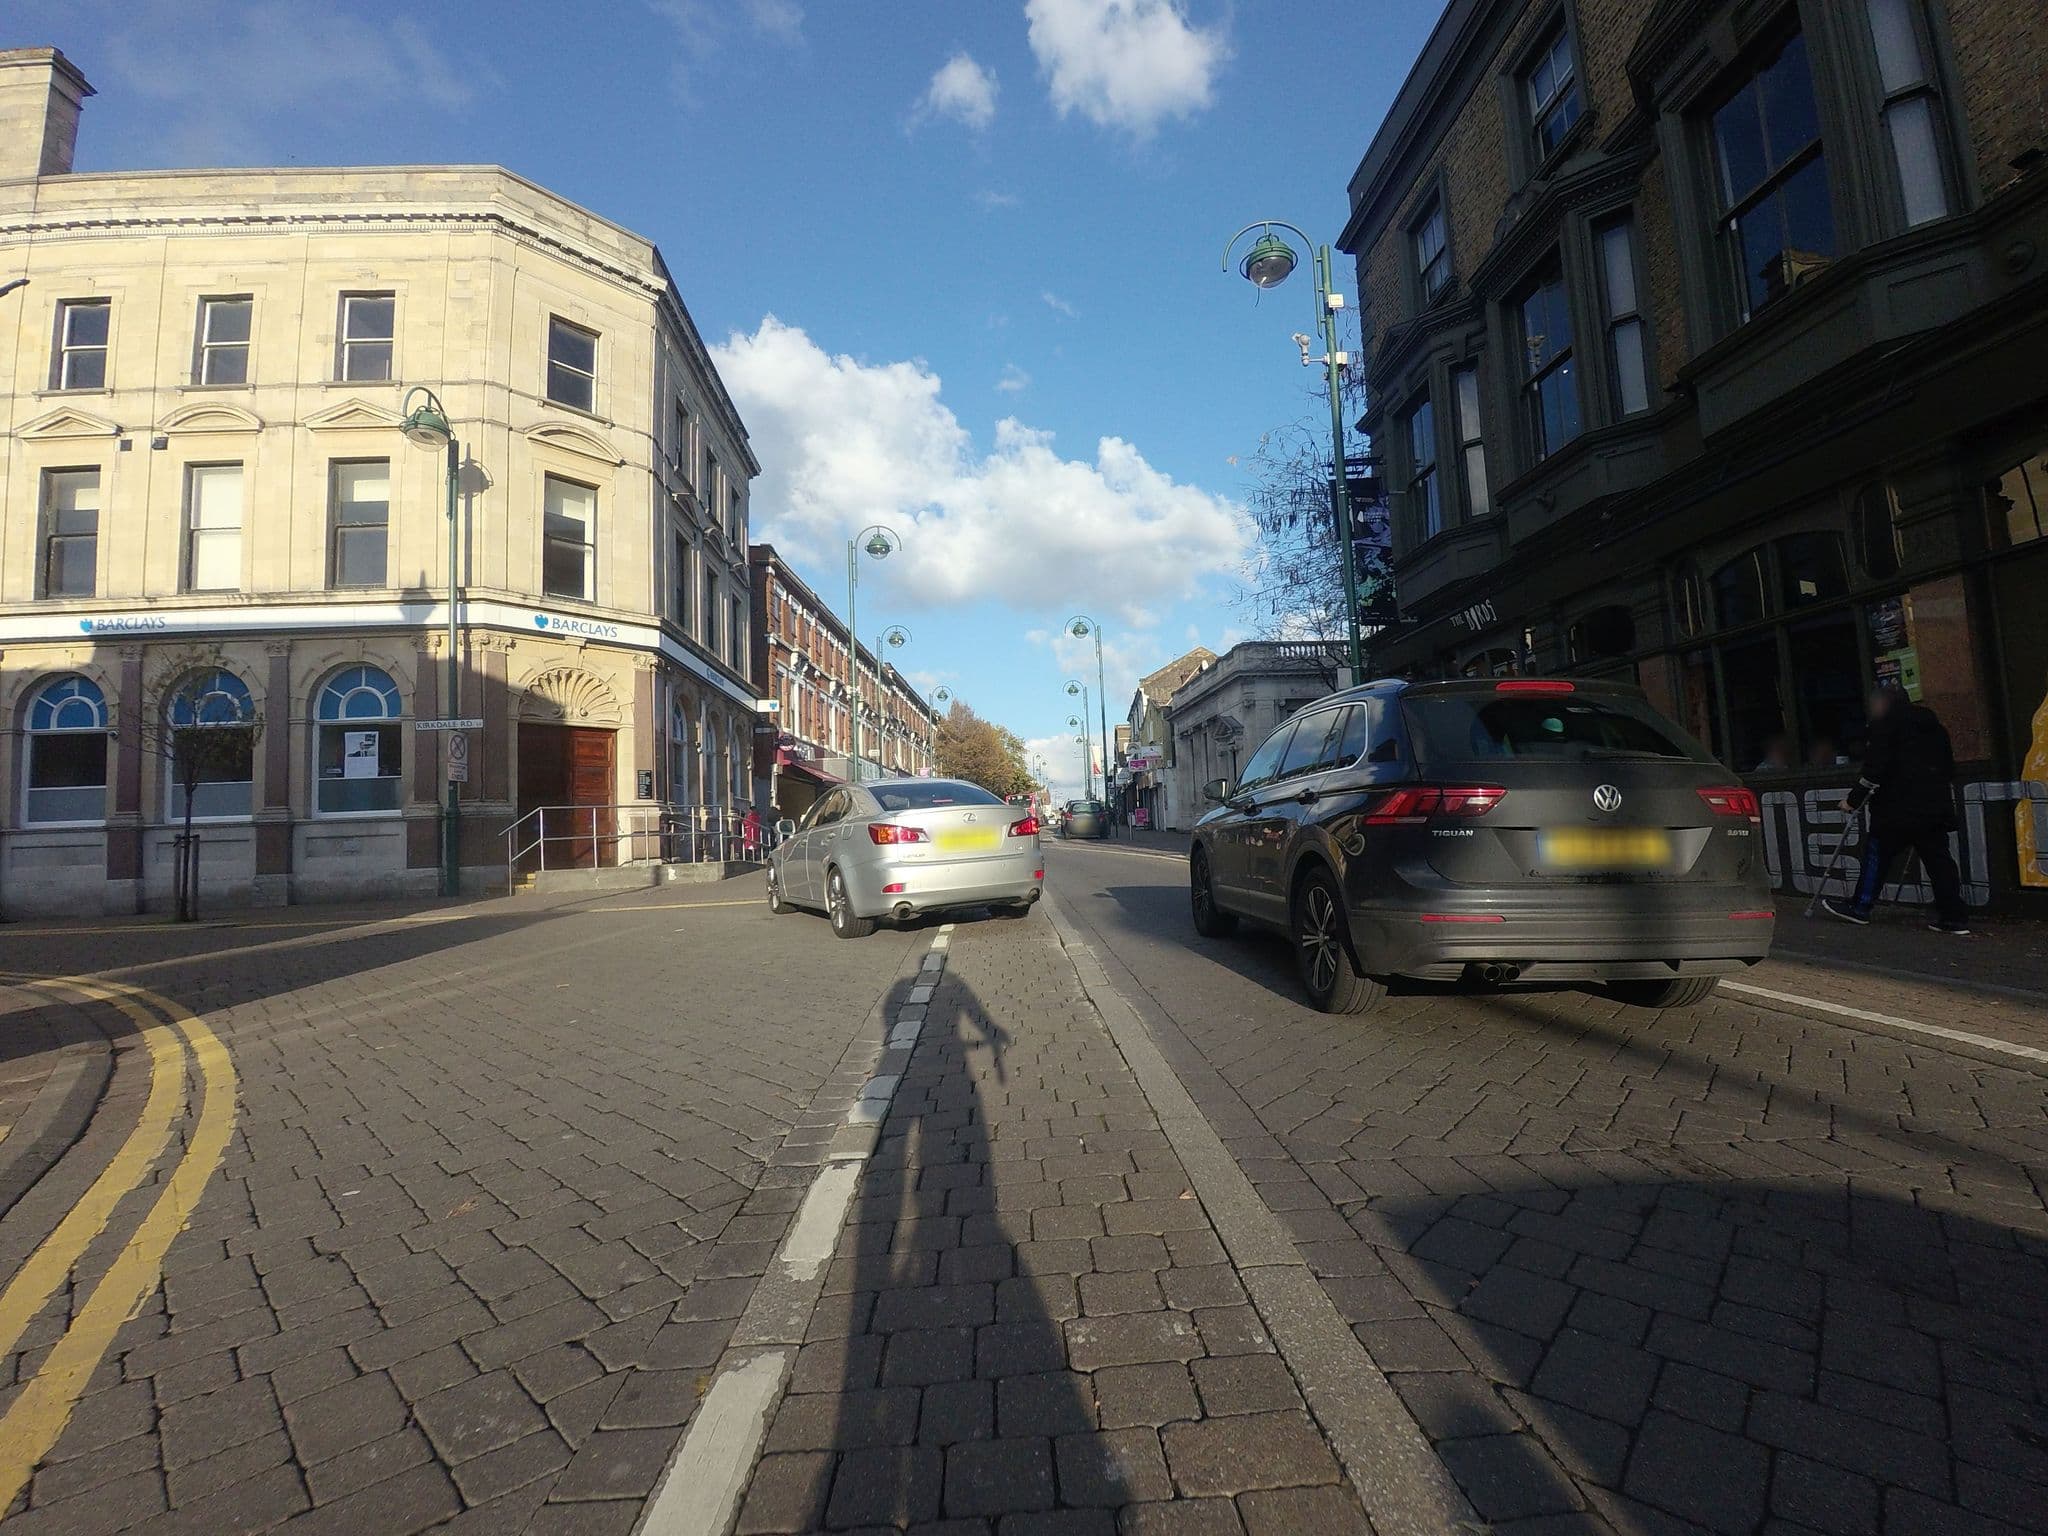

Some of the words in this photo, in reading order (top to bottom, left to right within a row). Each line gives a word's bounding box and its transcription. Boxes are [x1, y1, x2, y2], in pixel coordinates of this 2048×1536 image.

[96, 616, 166, 631] BARCLAYS
[1449, 613, 1465, 627] THE
[552, 617, 618, 638] BARCLAYS
[416, 721, 458, 729] KIRKDALE
[1431, 829, 1474, 837] TIGUAN
